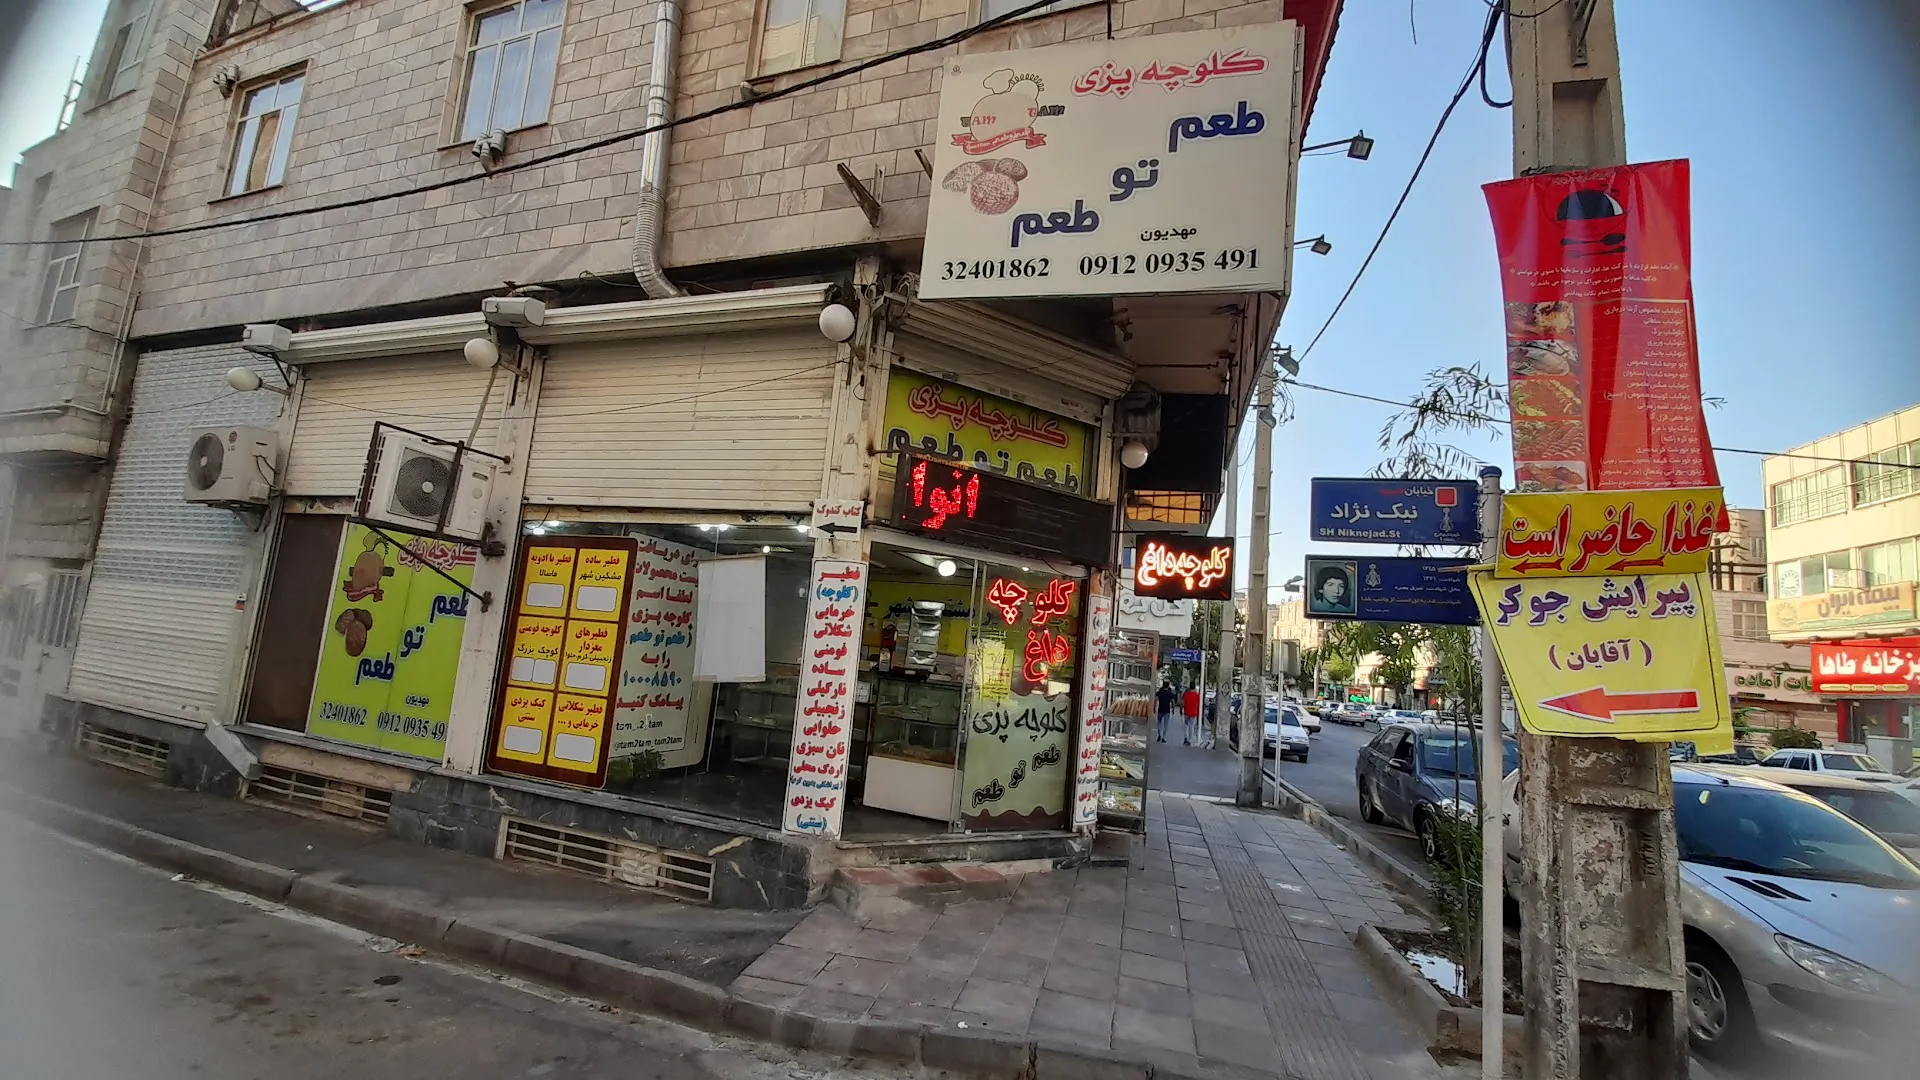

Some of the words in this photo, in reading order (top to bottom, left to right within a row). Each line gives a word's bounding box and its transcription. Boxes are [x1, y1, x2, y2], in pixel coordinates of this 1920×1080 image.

[1073, 61, 1134, 97] پزی
[1137, 50, 1267, 92] کلوچه
[1167, 101, 1265, 153] طعم
[1110, 158, 1160, 202] تو
[1011, 199, 1101, 248] طعم
[1140, 226, 1197, 242] مهدیون
[941, 258, 1050, 281] 32401862
[1079, 254, 1136, 276] 0912
[1145, 251, 1206, 274] 0935
[1214, 248, 1260, 270] 491
[908, 384, 968, 431] پزی
[966, 397, 1070, 449] کلوچه
[1016, 461, 1080, 495] طعم
[1403, 486, 1435, 497] خیابان
[1330, 502, 1371, 524] نژاد
[1376, 502, 1418, 524] نیک
[1319, 527, 1335, 537] SH
[1502, 503, 1574, 560] است
[1567, 502, 1658, 573] حاضر
[1660, 499, 1716, 556] غذا
[579, 569, 594, 580] شهر
[817, 565, 861, 583] فطیر
[1137, 541, 1176, 587] داغ
[1175, 546, 1230, 590] کلوچه
[636, 585, 665, 600] اسم
[665, 586, 693, 604] لطفا
[631, 607, 662, 626] پزی
[663, 610, 693, 628] کلوچه
[814, 603, 856, 622] خرمایی
[813, 622, 853, 639] شکلاتی
[400, 625, 426, 658] تو
[517, 643, 535, 656] بزرگ
[538, 645, 559, 658] کوچک
[814, 642, 848, 660] فومنی
[640, 652, 660, 668] به
[662, 650, 671, 669] را
[1023, 629, 1069, 682] داغ
[1819, 649, 1858, 676] طاها
[355, 651, 396, 687] طعم
[811, 661, 846, 677] ساده
[806, 680, 847, 700] نارگیلی
[615, 693, 649, 712] کنید
[648, 692, 685, 712] پیامک
[803, 699, 846, 720] زنجبیلی
[319, 701, 368, 726] 32401862
[377, 710, 402, 733] 0912
[403, 717, 431, 739] 0935
[803, 720, 842, 739] حلوایی
[972, 702, 1011, 744] پزی
[1013, 704, 1069, 742] کلوچه
[796, 740, 825, 757] سبزی
[826, 741, 846, 759] نان
[1031, 743, 1061, 771] طعم
[1009, 760, 1027, 788] تو
[790, 795, 813, 809] یزدی
[972, 778, 1006, 808] طعم
[814, 797, 837, 811] کیک
